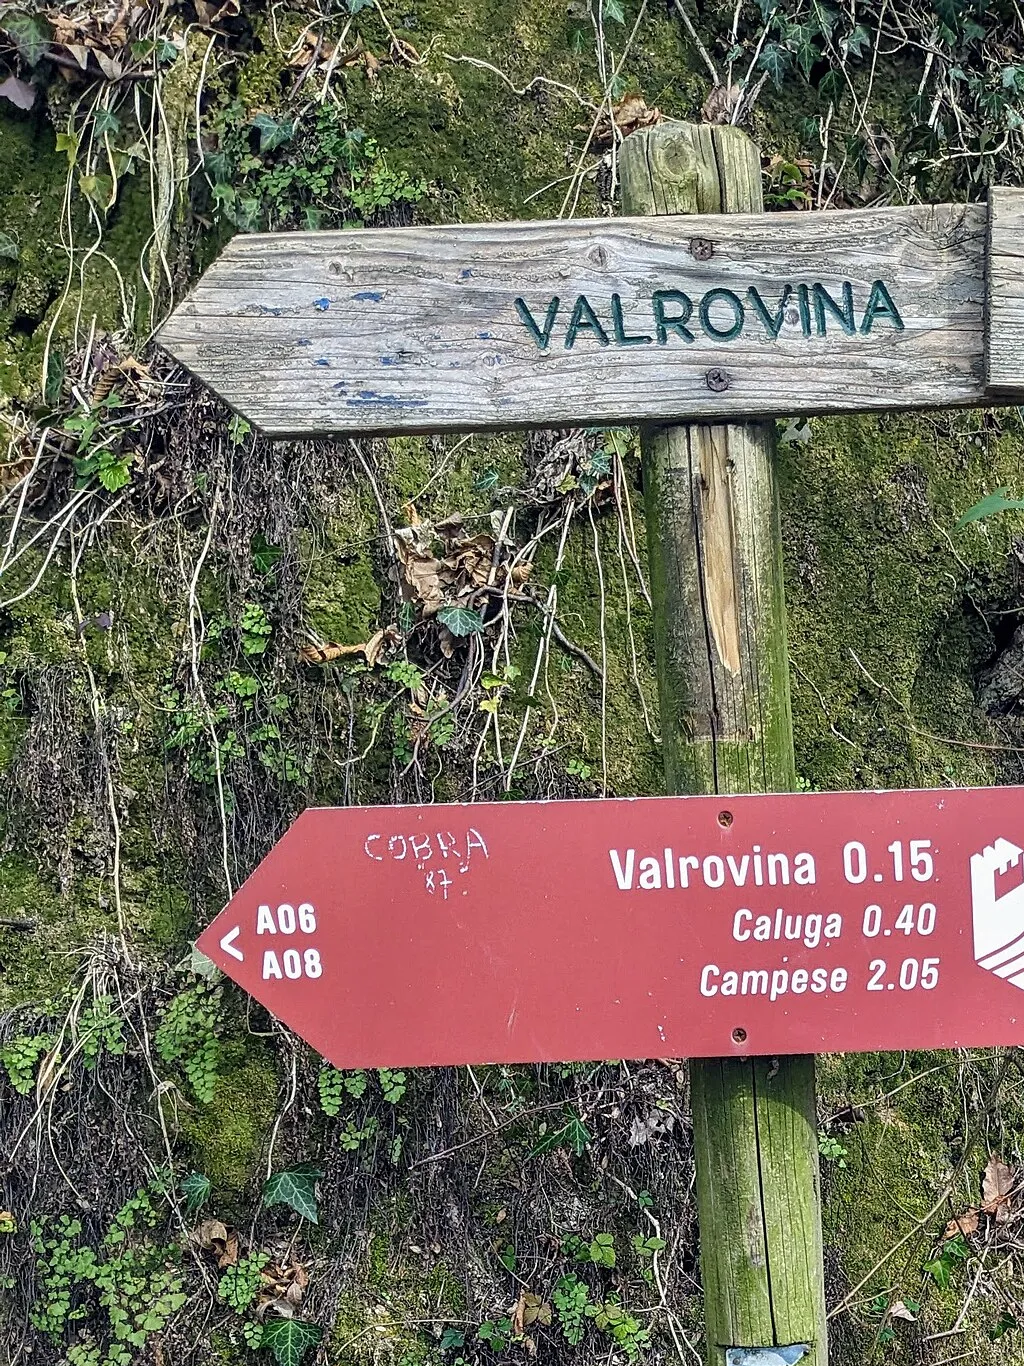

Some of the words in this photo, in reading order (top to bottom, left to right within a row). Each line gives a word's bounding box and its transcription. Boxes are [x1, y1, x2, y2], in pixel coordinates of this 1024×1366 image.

[515, 281, 906, 350] VALROVINA
[364, 829, 489, 861] COBRA
[609, 845, 817, 890] Valrovina
[843, 840, 935, 883] 0.15
[256, 904, 317, 935] A06
[732, 908, 842, 948] Caluga
[862, 903, 938, 938] 0.40
[262, 949, 323, 979] A08
[699, 965, 849, 1002] Campese
[866, 958, 941, 992] 2.05
